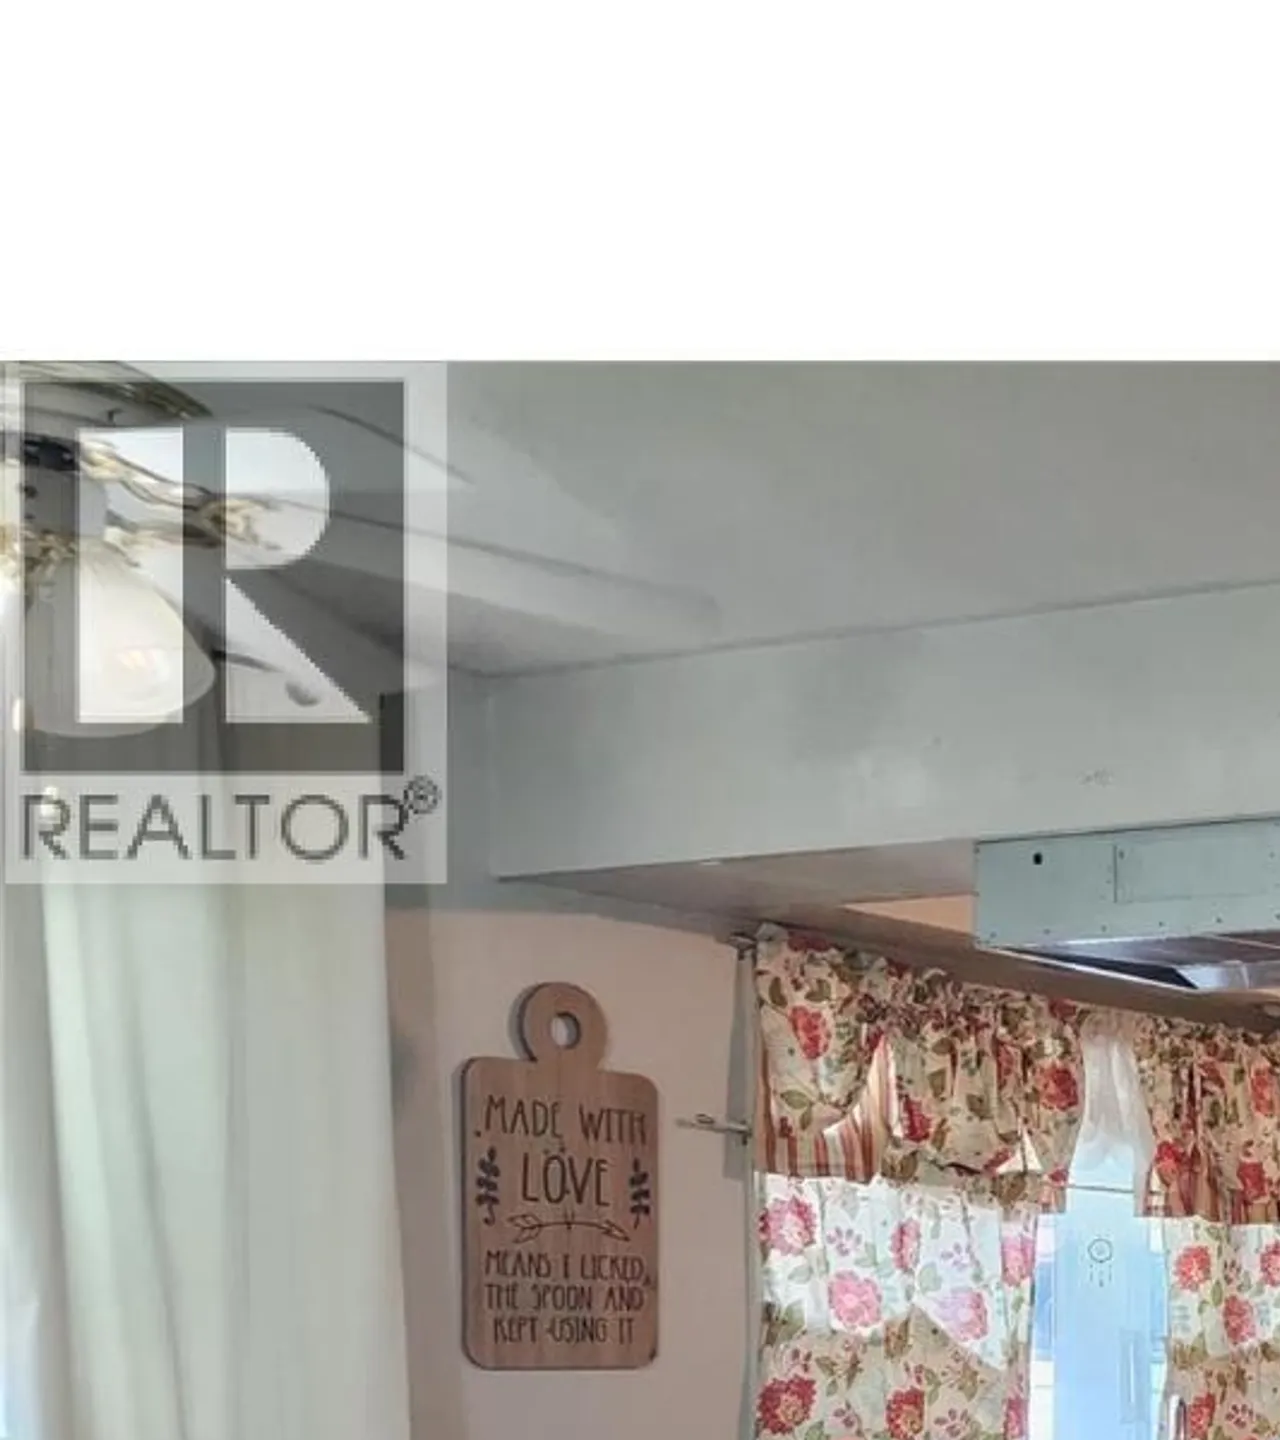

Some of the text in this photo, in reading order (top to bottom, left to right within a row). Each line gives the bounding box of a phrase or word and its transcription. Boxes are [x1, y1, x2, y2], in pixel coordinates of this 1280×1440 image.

[485, 1094, 647, 1146] MADE WITH
[522, 1153, 610, 1207] LOVE
[485, 1250, 550, 1279] MEANS
[485, 1283, 644, 1312] THE SPOON AND
[494, 1316, 635, 1345] KEPT USING IT
